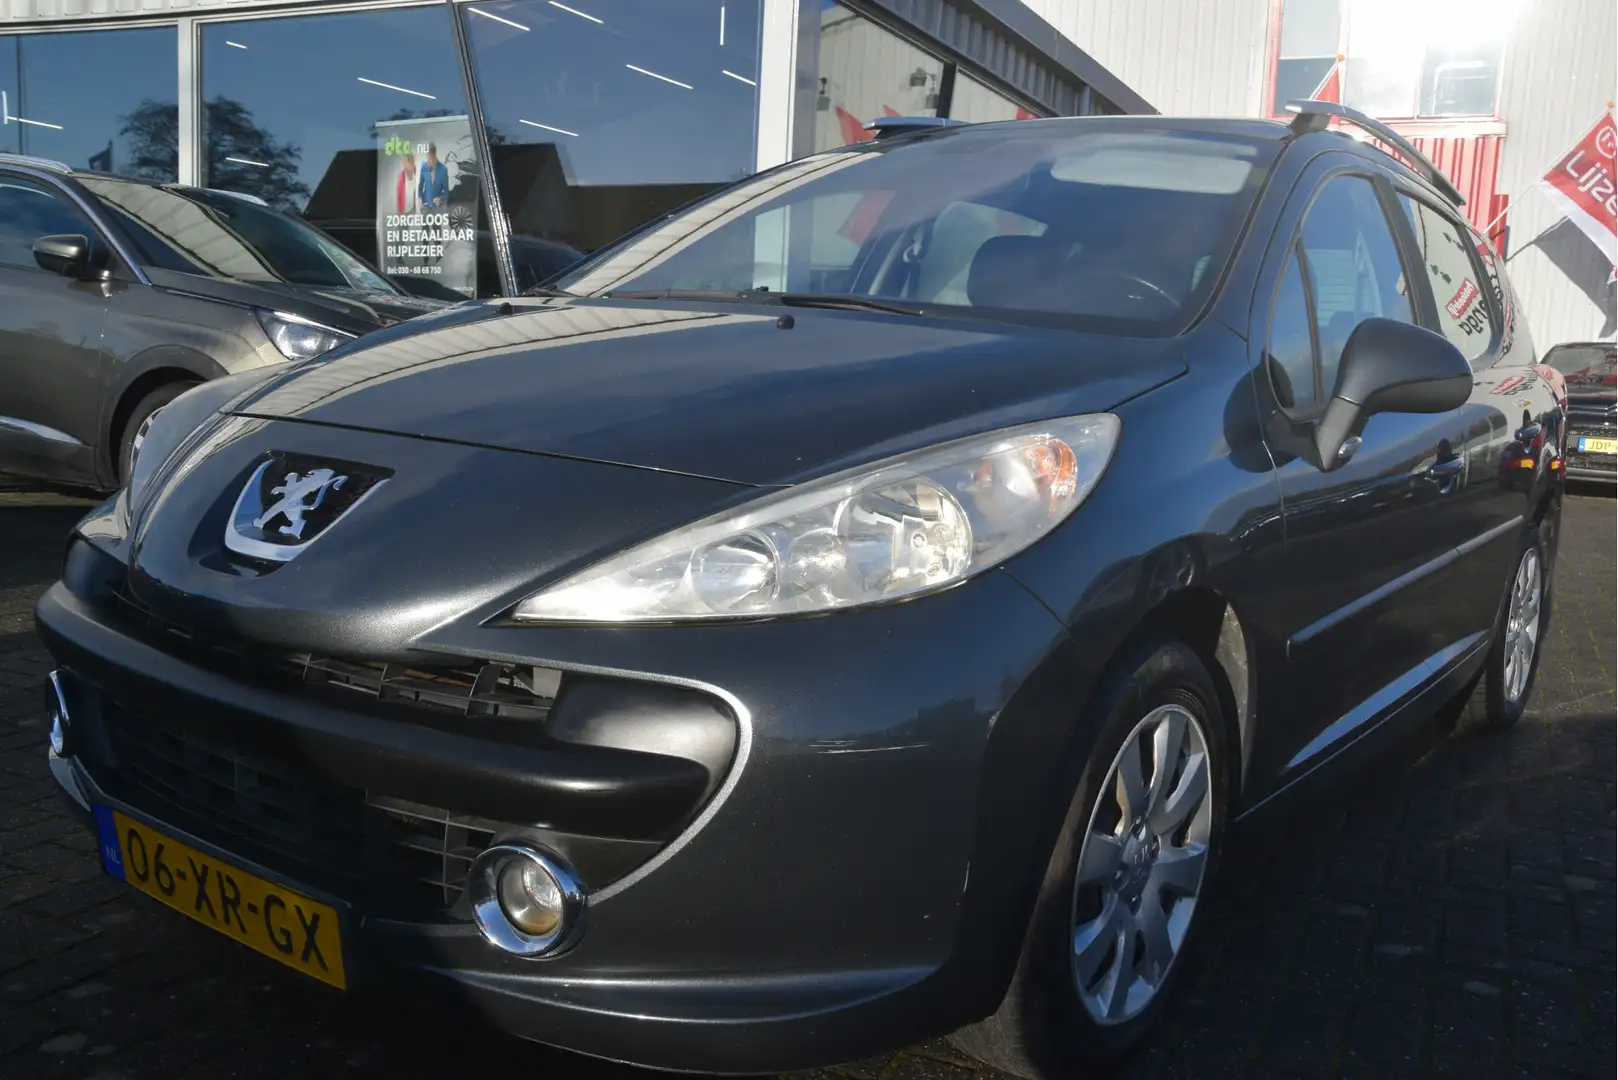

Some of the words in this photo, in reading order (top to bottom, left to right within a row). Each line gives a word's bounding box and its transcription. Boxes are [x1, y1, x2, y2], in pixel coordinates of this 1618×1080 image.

[386, 213, 449, 227] ZORGELOOS
[387, 230, 399, 242] EN
[402, 228, 474, 241] BETAALBAAR
[387, 245, 443, 257] RIJPLEZIER
[127, 828, 329, 971] 06-XR-GX
